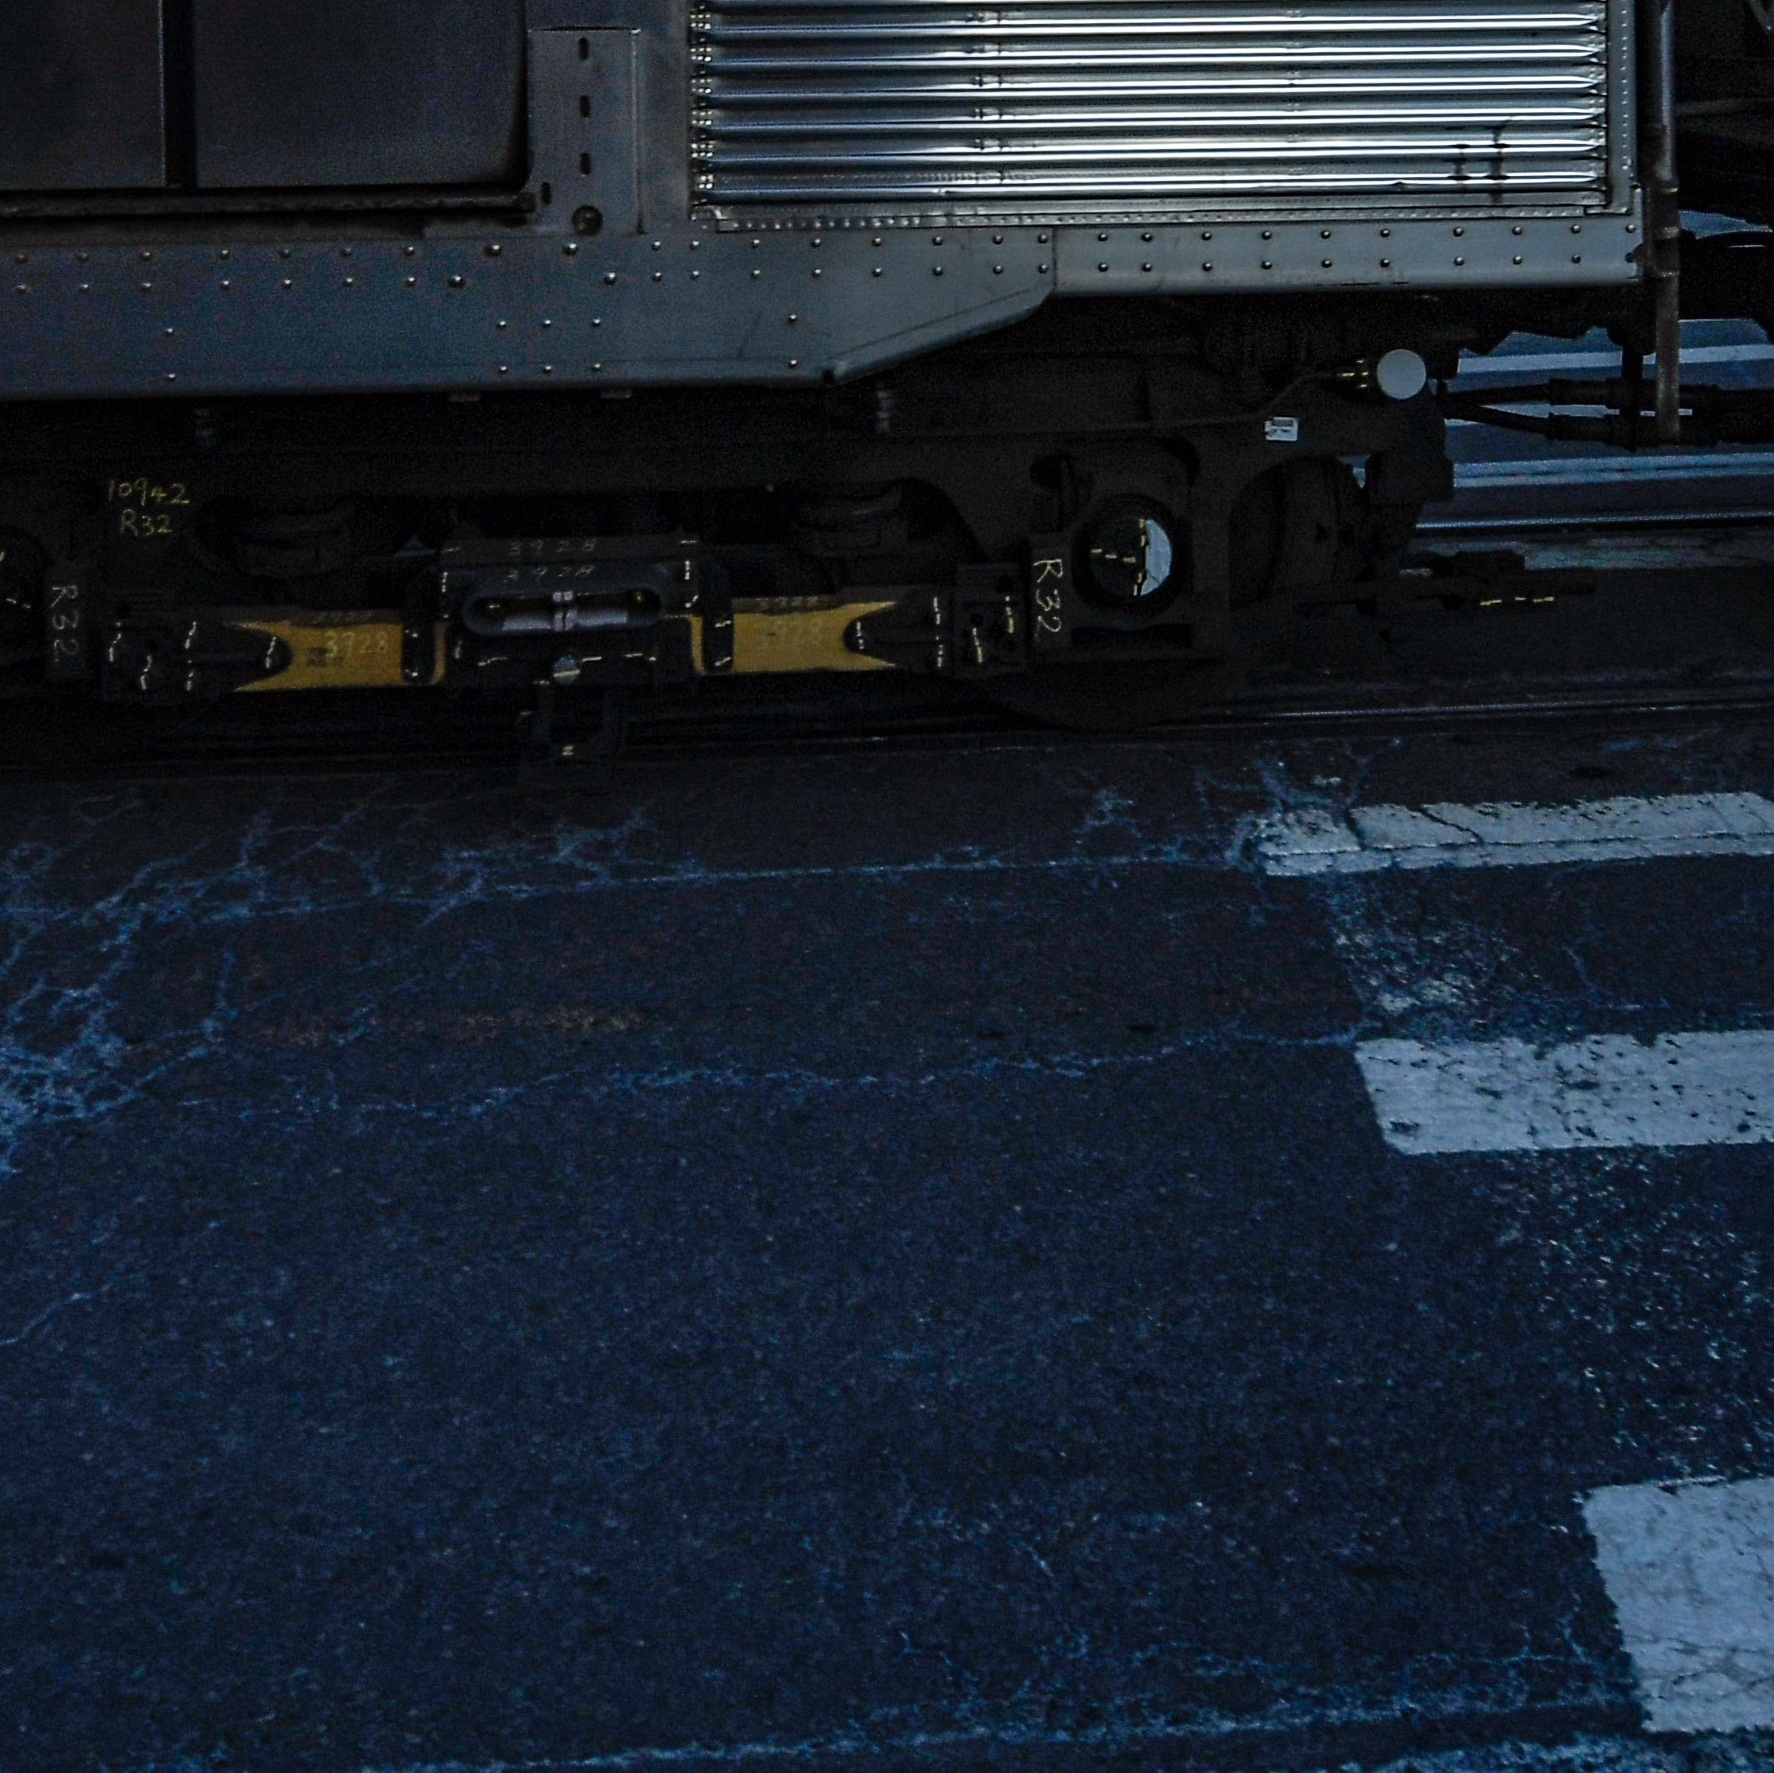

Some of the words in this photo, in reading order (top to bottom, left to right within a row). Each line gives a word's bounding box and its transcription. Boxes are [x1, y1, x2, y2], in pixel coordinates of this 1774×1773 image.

[106, 476, 190, 507] 10942
[119, 508, 173, 538] R32
[49, 584, 80, 663] R32
[1031, 557, 1064, 640] R32
